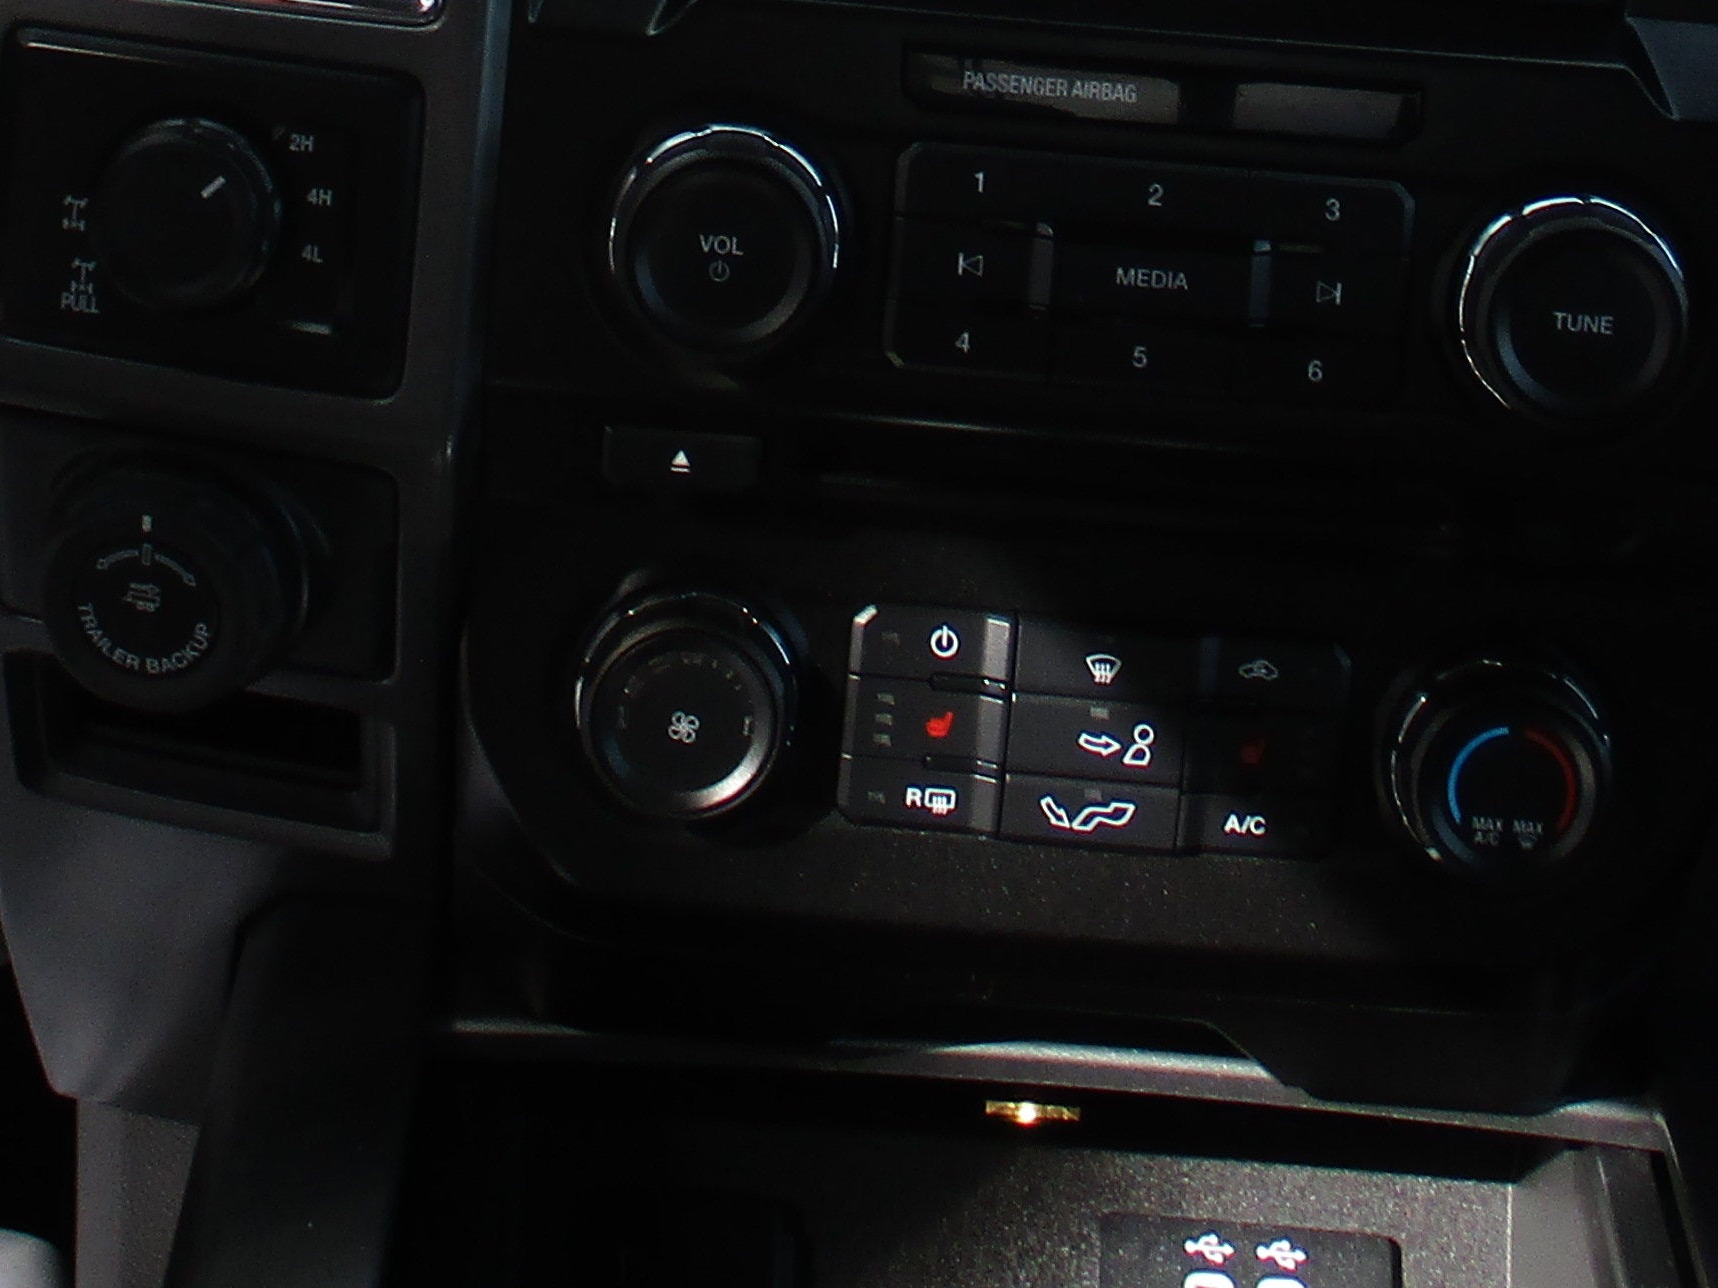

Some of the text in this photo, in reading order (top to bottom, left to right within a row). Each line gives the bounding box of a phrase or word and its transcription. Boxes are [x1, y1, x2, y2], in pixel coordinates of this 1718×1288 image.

[962, 69, 1138, 104] PASSENGER AIRBAG
[288, 132, 315, 153] 2H
[973, 172, 985, 193] 1
[306, 187, 334, 207] 4H
[1148, 185, 1164, 207] 2
[1325, 199, 1341, 221] 3
[699, 234, 743, 257] VOL
[1115, 266, 1189, 292] MEDIA
[60, 291, 101, 315] PULL
[1554, 311, 1614, 336] TUNE
[955, 332, 971, 354] 4
[1133, 347, 1148, 368] 5
[1308, 360, 1323, 382] 6
[77, 603, 210, 675] TRAILER BACKUP
[1223, 814, 1266, 837] A/C
